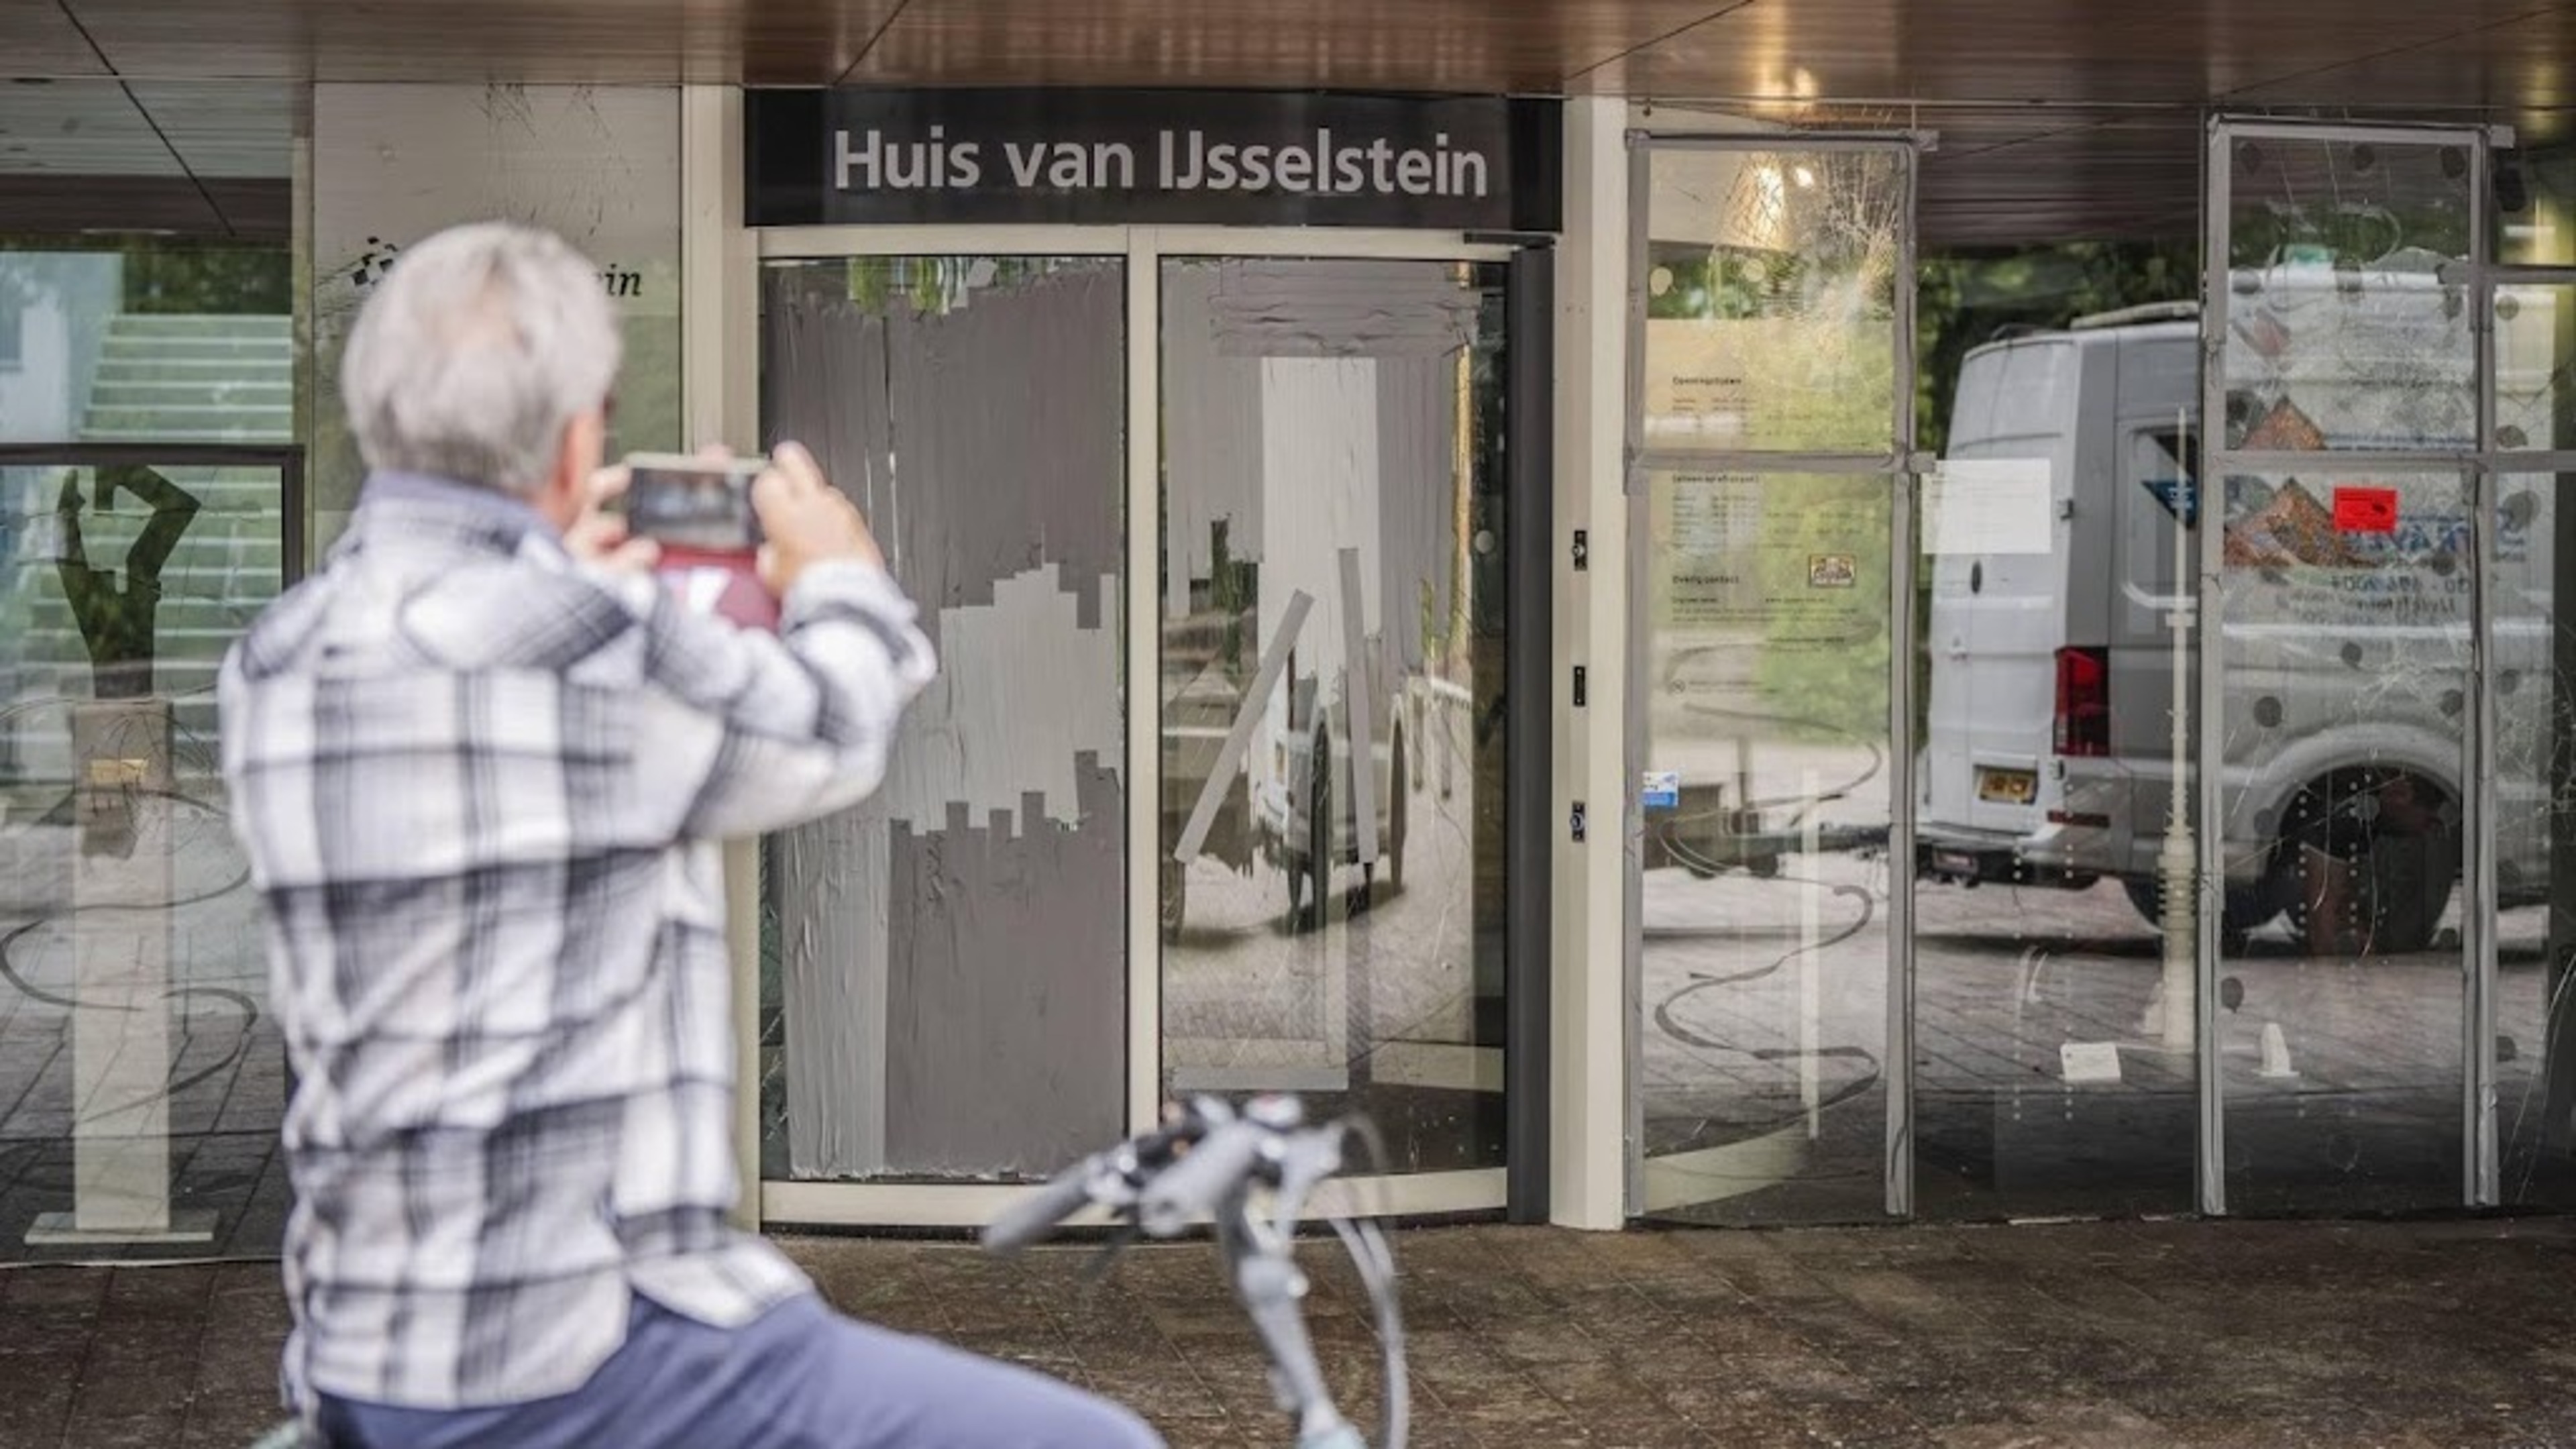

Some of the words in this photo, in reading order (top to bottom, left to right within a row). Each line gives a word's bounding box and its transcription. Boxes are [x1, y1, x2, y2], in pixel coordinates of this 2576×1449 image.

[836, 127, 979, 187] Huis
[1005, 144, 1132, 186] van
[1161, 129, 1487, 195] IJsselstein
